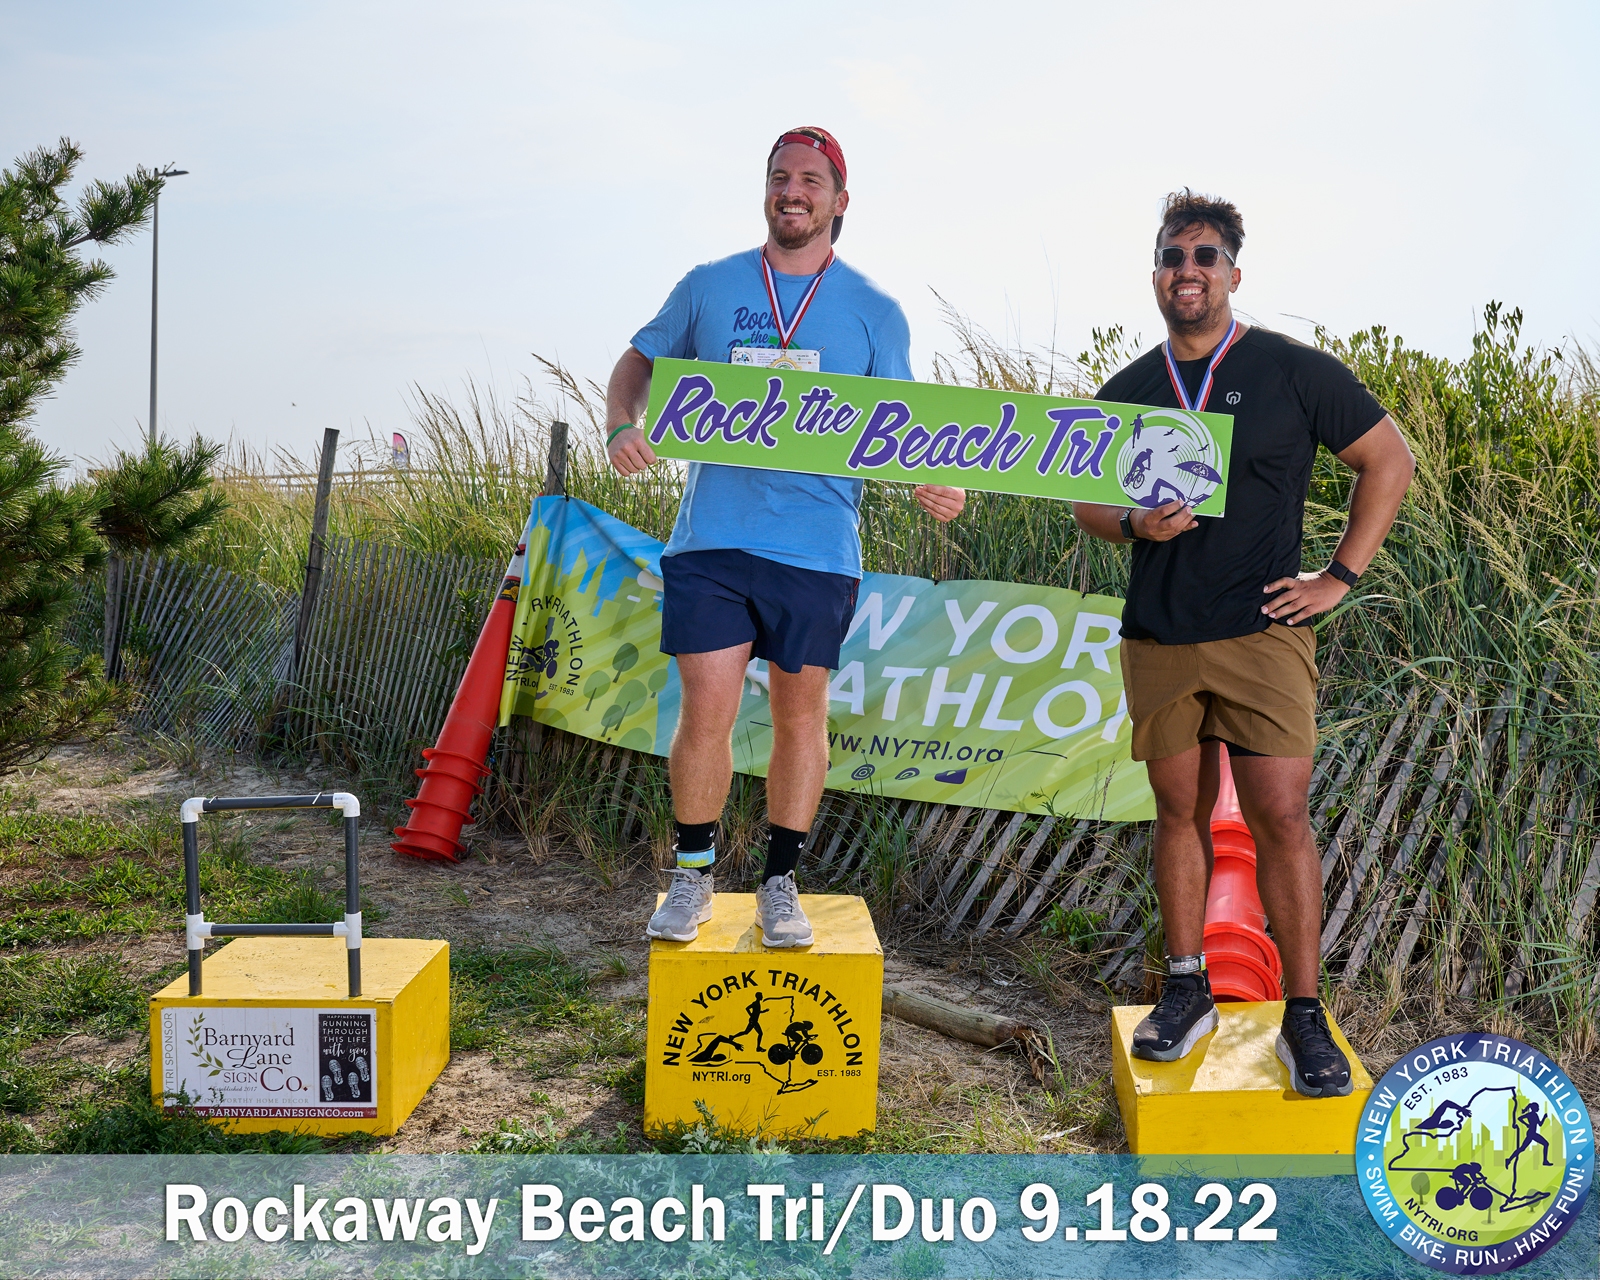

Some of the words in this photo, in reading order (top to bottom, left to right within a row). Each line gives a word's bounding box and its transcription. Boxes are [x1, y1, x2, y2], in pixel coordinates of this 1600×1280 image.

[733, 306, 777, 332] Rock
[750, 330, 769, 343] the
[650, 375, 788, 449] Rock
[794, 387, 861, 434] the
[847, 400, 1035, 472] Beach
[1037, 407, 1122, 479] Tri
[506, 635, 524, 681] NEW
[552, 597, 583, 686] RIATHLON
[944, 599, 1123, 674] YOR
[559, 686, 575, 696] 1983
[663, 1012, 694, 1067] NEW
[690, 969, 759, 1010] YORK
[768, 969, 863, 1066] TRIATHLON
[163, 1012, 174, 1066] SPONSOR
[203, 1027, 295, 1048] Barnyard
[226, 1045, 292, 1069] Lane
[322, 1042, 346, 1057] with
[348, 1047, 368, 1063] you
[164, 1068, 174, 1101] YTRI
[223, 1071, 258, 1083] SIGN
[260, 1066, 308, 1091] Co.
[692, 1071, 751, 1084] NYTRI.org
[840, 1069, 862, 1077] 1983
